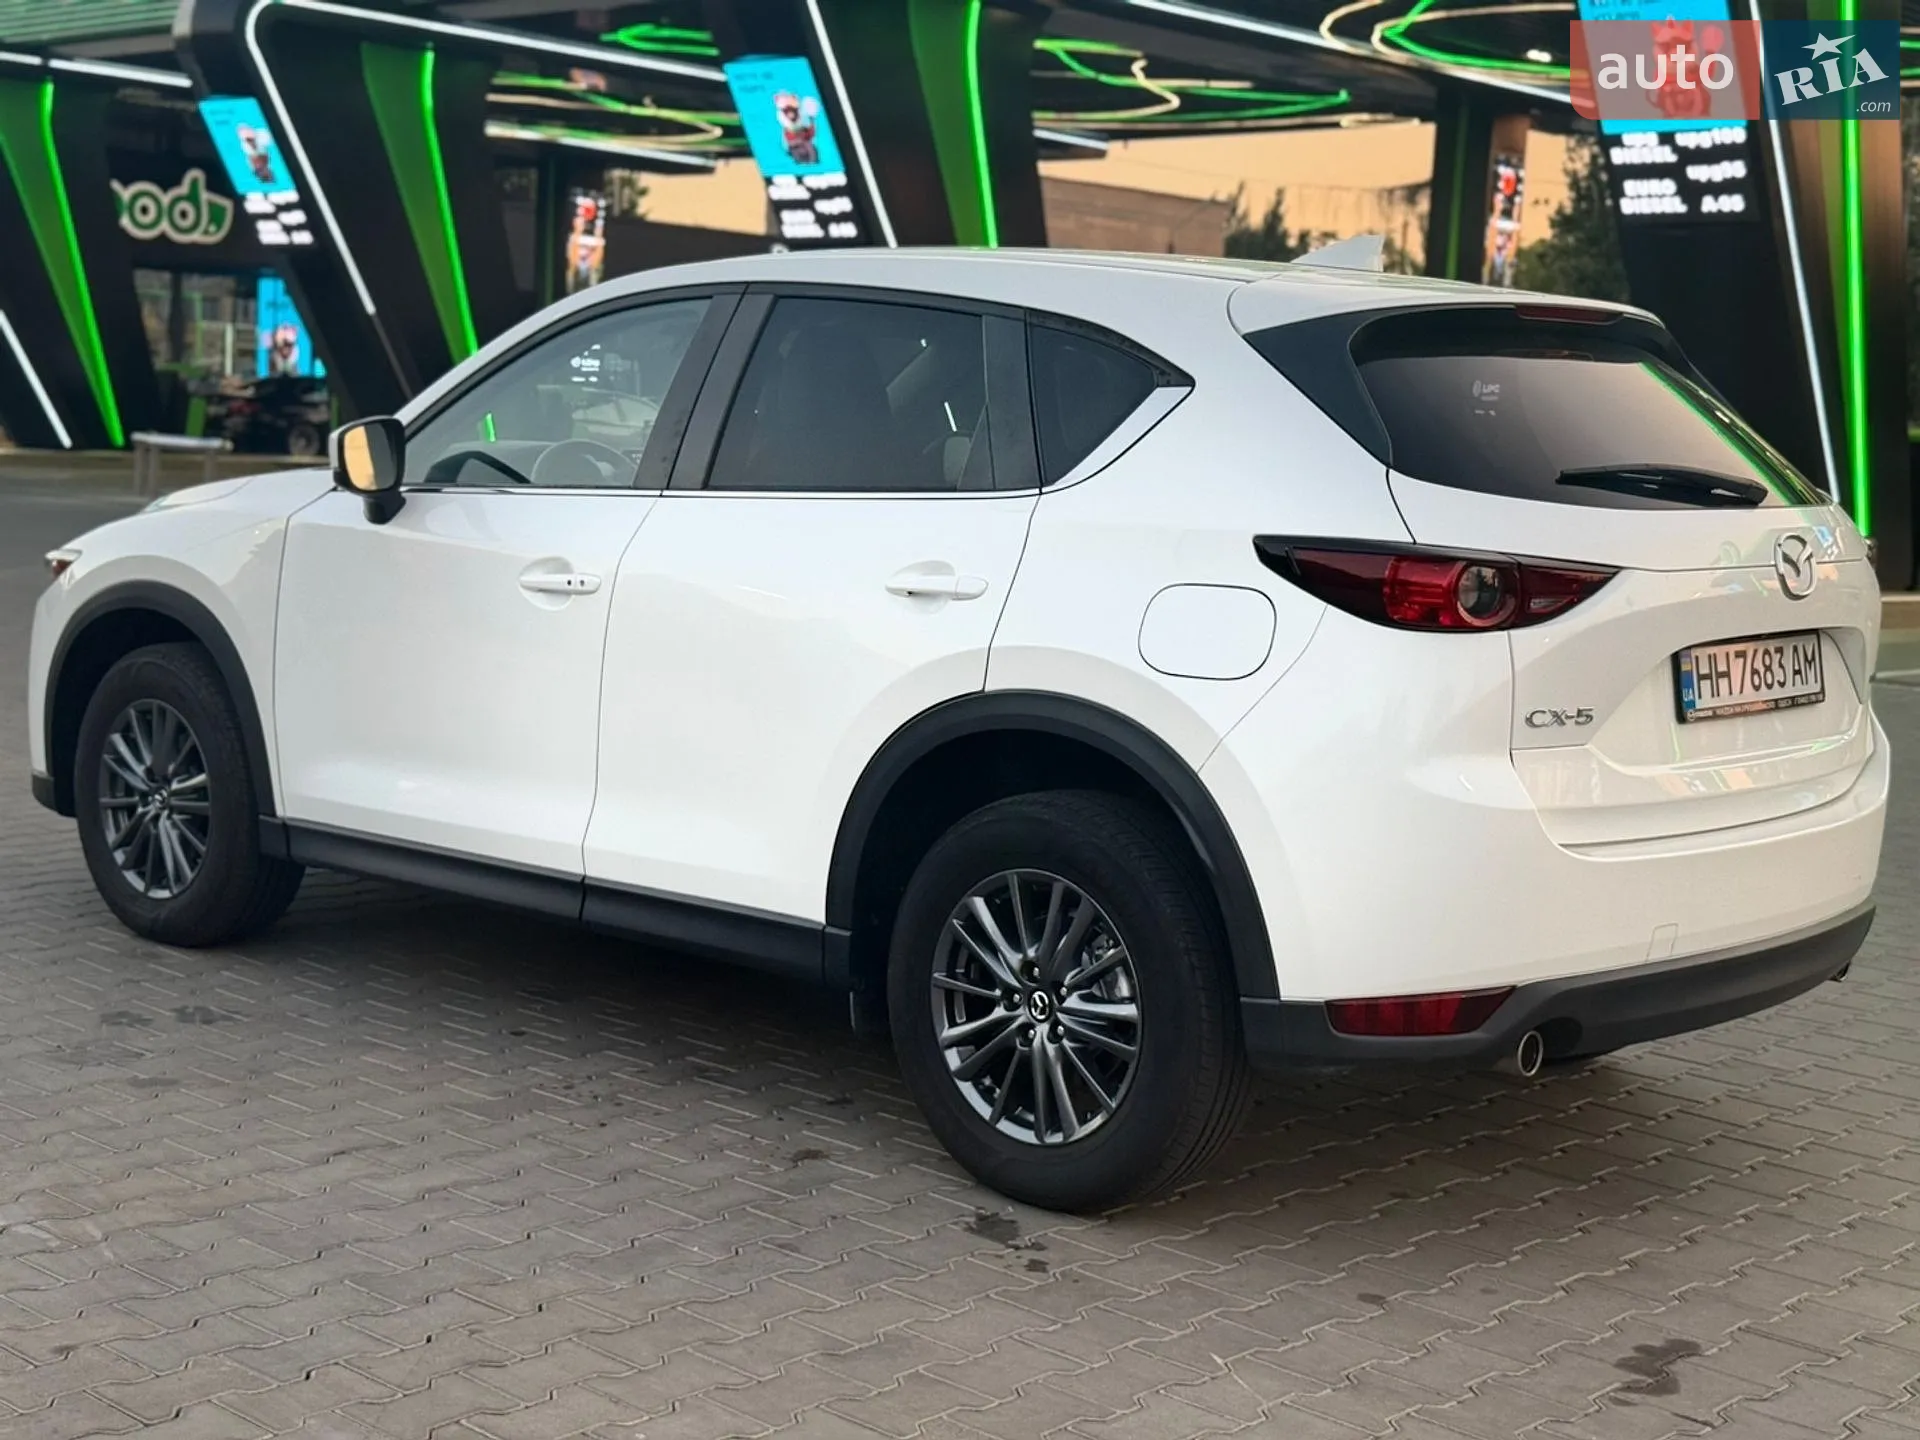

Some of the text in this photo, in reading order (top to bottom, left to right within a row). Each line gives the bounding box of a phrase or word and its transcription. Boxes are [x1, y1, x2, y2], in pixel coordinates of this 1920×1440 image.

[1610, 145, 1678, 165] DIESEL
[1619, 196, 1688, 215] DIESEL
[1682, 687, 1693, 701] UA
[1525, 706, 1594, 728] CX-5
